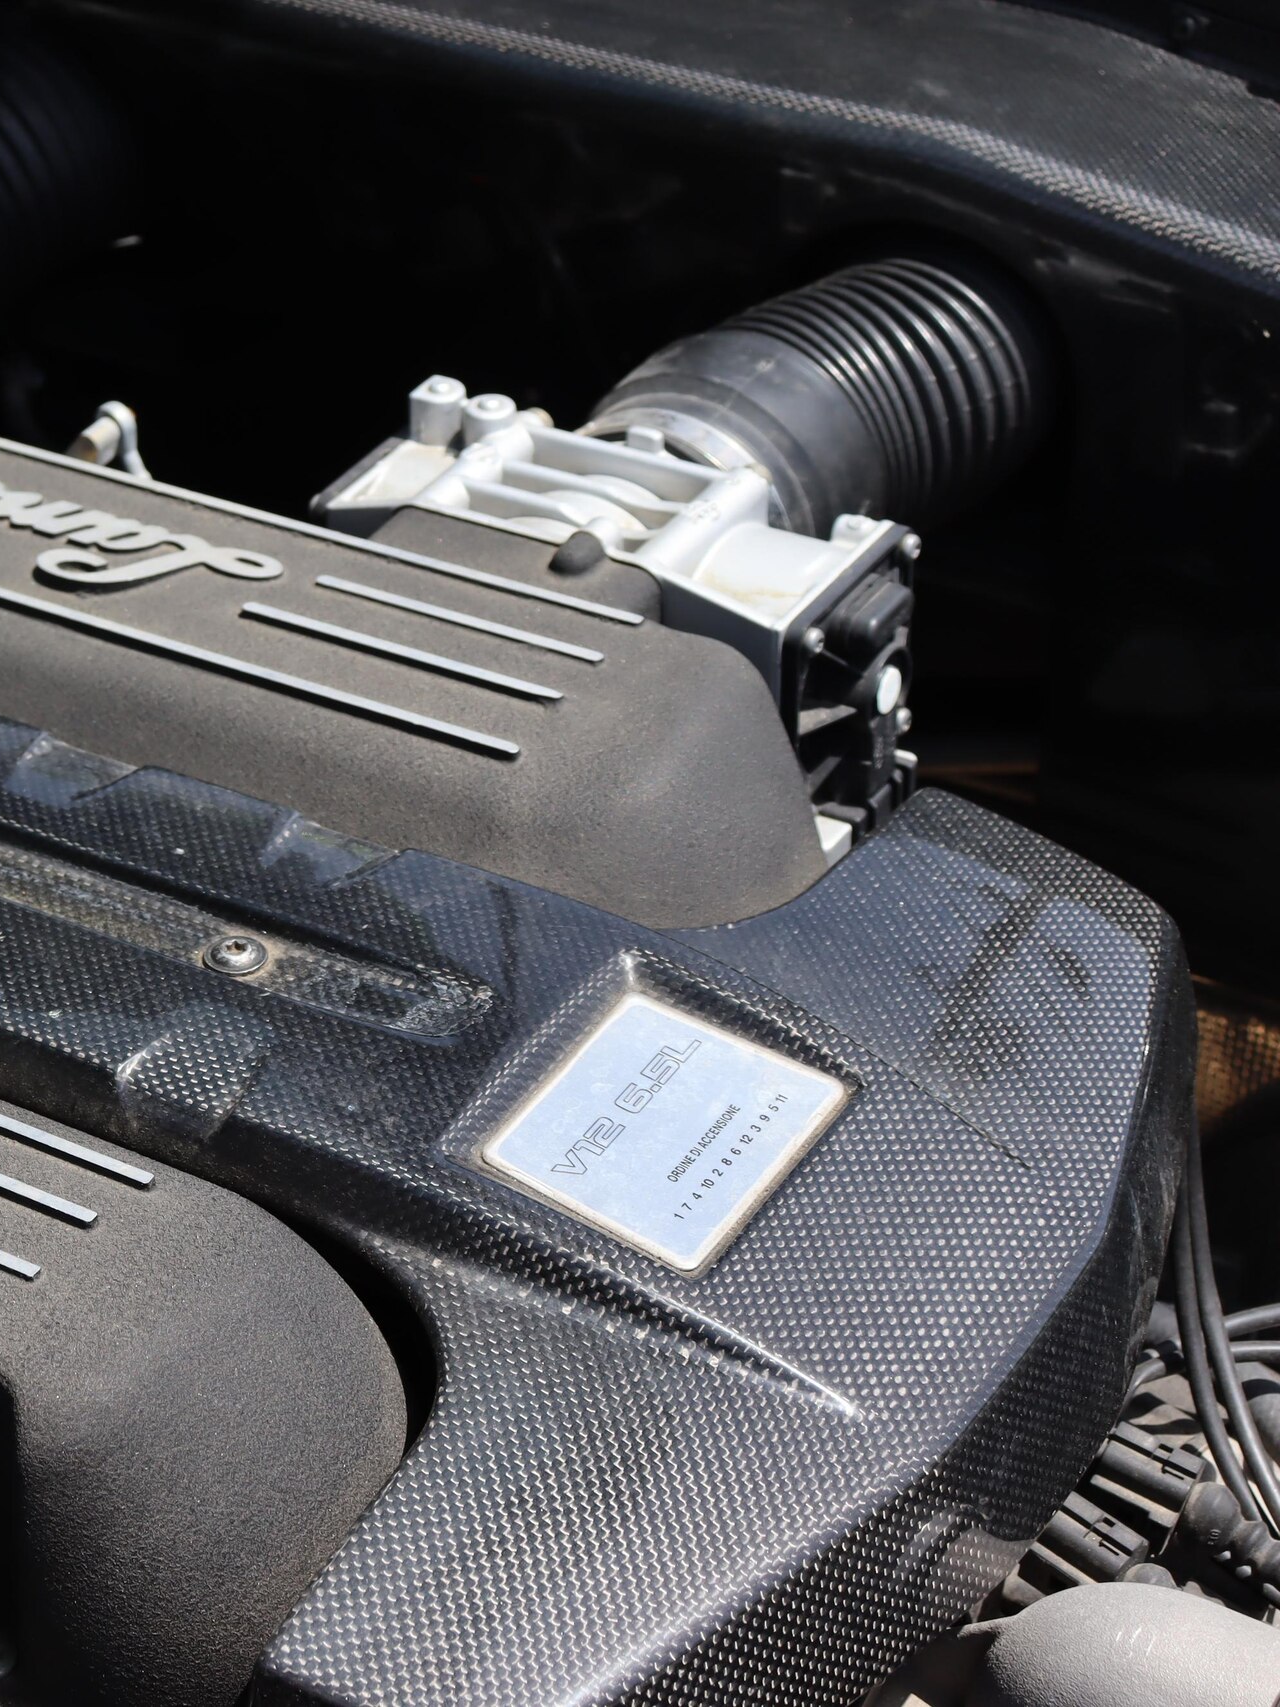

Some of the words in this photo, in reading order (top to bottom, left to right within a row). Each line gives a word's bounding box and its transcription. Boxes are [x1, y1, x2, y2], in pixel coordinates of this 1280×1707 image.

[550, 1116, 626, 1175] V12
[614, 1039, 702, 1114] 6.5L
[666, 1154, 697, 1183] ORDINE
[689, 1146, 704, 1157] DI
[697, 1103, 741, 1150] ACCENSIONE
[673, 1212, 685, 1220] 1
[681, 1202, 693, 1211] 7
[691, 1191, 703, 1200] 4
[700, 1178, 715, 1190] 10
[711, 1168, 724, 1177] 2
[721, 1157, 733, 1166] 8
[730, 1147, 742, 1156] 6
[739, 1134, 754, 1145] 12
[750, 1124, 762, 1133] 3
[759, 1114, 771, 1122] 9
[767, 1103, 780, 1112] 5
[775, 1093, 789, 1103] 11
